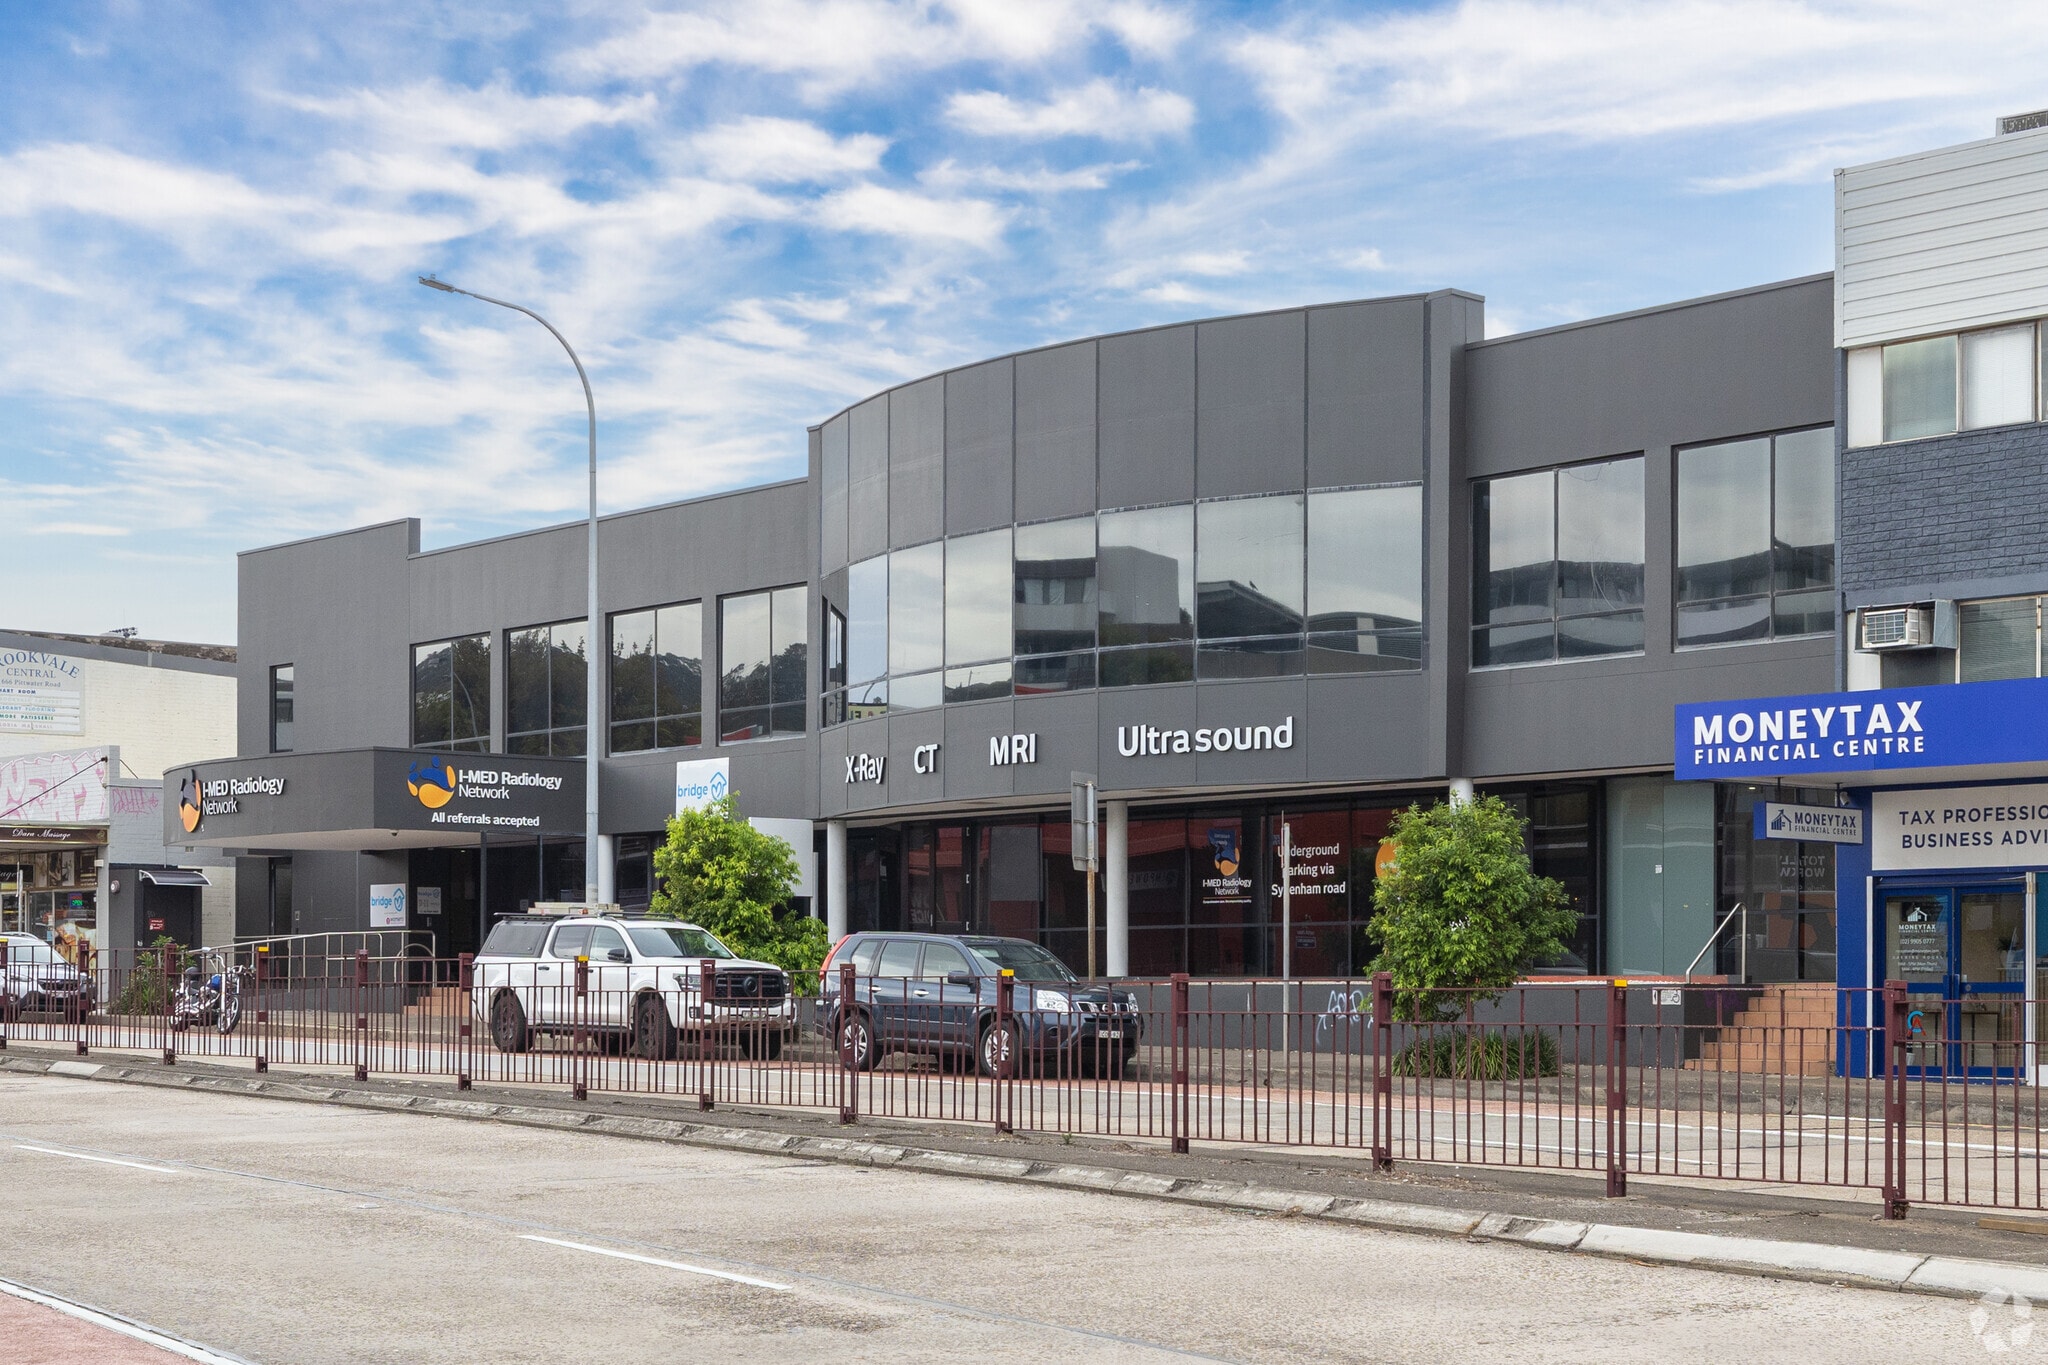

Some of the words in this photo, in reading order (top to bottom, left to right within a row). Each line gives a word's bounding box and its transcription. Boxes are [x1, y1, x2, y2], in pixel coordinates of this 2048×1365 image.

[6, 667, 56, 679] CENTRAL
[1693, 700, 1924, 746] MONEYTAX
[1117, 716, 1294, 757] Ultrasound
[989, 733, 1037, 766] MRI
[1694, 742, 1821, 765] FINANCIAL
[1833, 736, 1925, 758] CENTRE
[913, 743, 939, 774] CT
[845, 753, 886, 784] X-Ray
[202, 779, 229, 798] I-MED
[230, 776, 285, 796] Radiology
[458, 769, 499, 785] I-MED
[501, 771, 563, 791] Radiology
[458, 784, 510, 800] Network
[677, 784, 709, 800] bridge
[202, 797, 238, 816] Network
[431, 812, 446, 824] All
[447, 813, 491, 825] referrals
[493, 816, 540, 828] accepted
[1794, 812, 1857, 828] MONEYTAX
[1899, 809, 1936, 826] TAX
[1943, 804, 2048, 824] PROFESSIO
[12, 828, 34, 837] Dara
[37, 828, 71, 840] Massage
[1794, 825, 1831, 835] FINANCIAL
[1832, 828, 1857, 837] CENTRE
[1902, 831, 1994, 849] BUSINESS
[2001, 829, 2048, 846] ADVI
[1277, 843, 1340, 859] Uderground
[1282, 863, 1318, 878] arking
[1320, 862, 1335, 875] via
[1202, 878, 1222, 888] I-MED
[1222, 877, 1252, 888] Radiology
[1271, 882, 1321, 898] Syenham
[1323, 881, 1346, 894] road
[1214, 887, 1240, 896] Network
[371, 896, 393, 909] bridge
